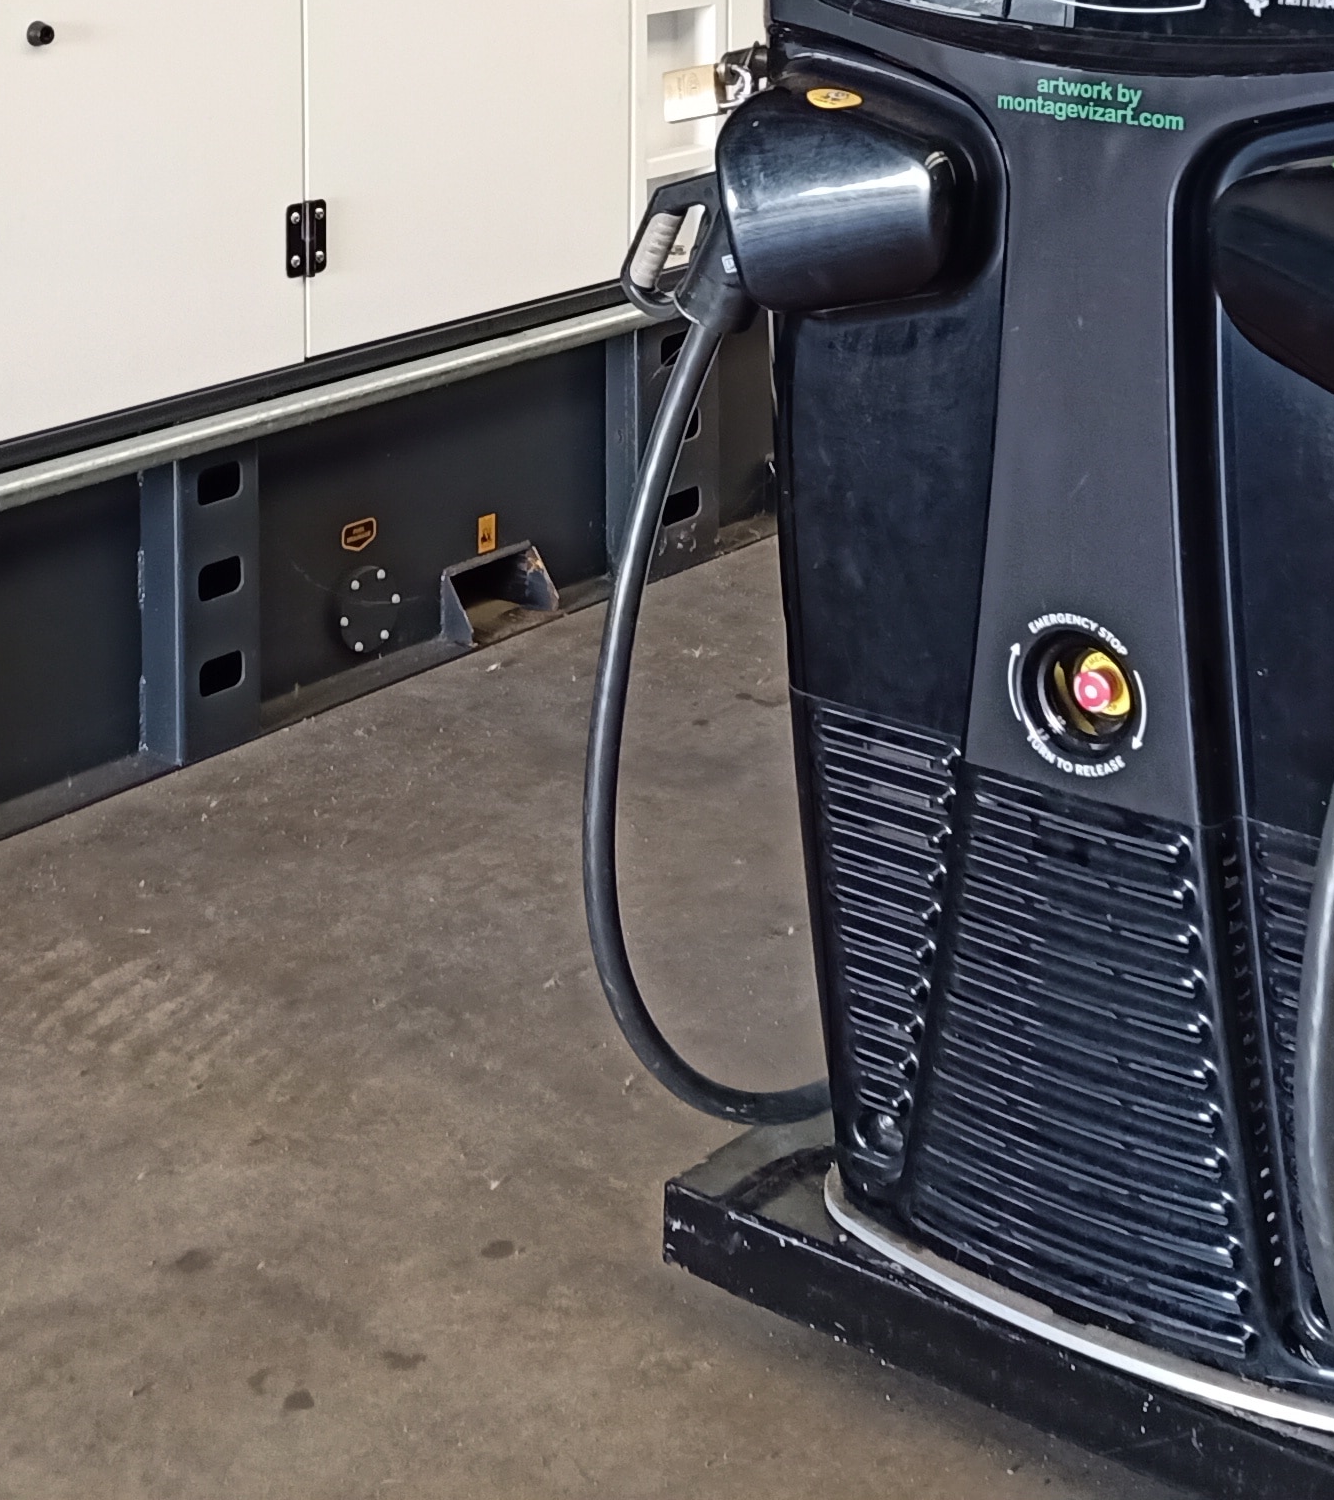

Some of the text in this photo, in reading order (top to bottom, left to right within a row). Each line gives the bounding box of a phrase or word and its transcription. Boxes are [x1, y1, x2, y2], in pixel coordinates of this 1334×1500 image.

[1037, 77, 1142, 108] artwork by
[997, 94, 1185, 131] montagevizart.com
[1028, 613, 1129, 655] EMERGENCY STOP
[1026, 733, 1126, 777] TURN TO RELEASE
